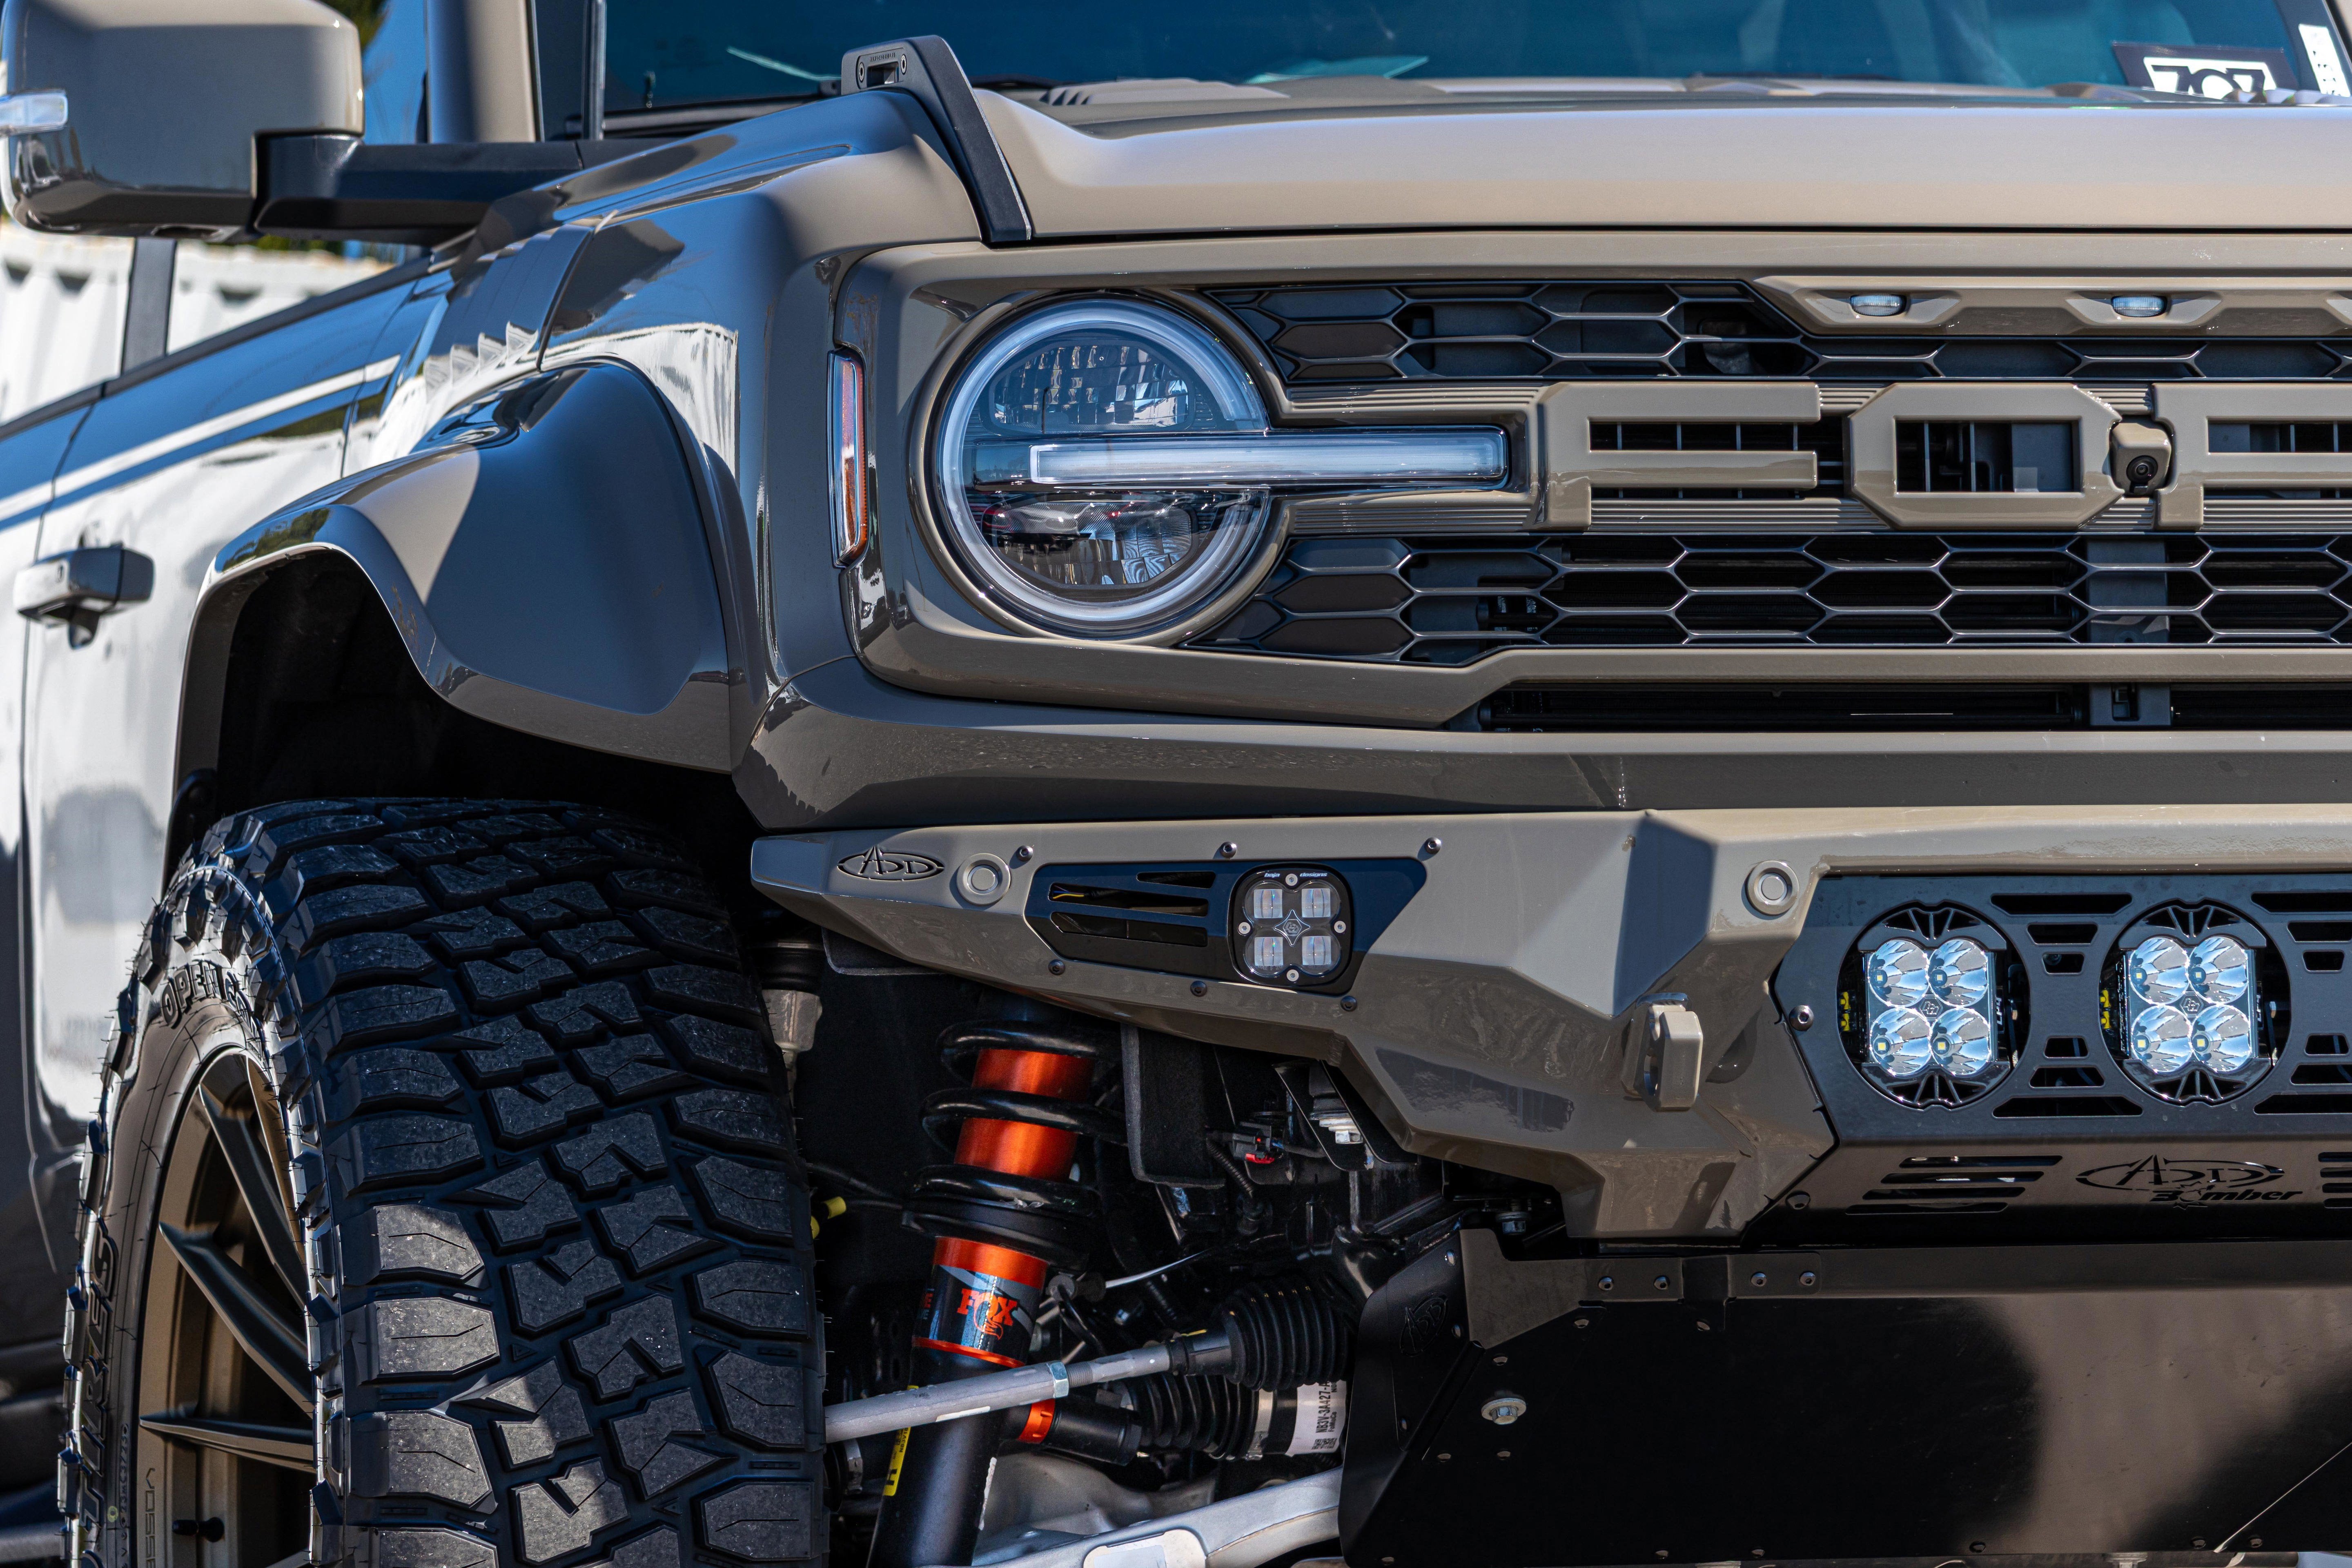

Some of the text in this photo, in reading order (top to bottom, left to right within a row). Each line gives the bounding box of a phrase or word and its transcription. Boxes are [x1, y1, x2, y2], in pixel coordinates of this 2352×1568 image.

[162, 962, 222, 1026] OPEN
[957, 1288, 1018, 1334] FOX
[80, 1216, 118, 1530] TIRES
